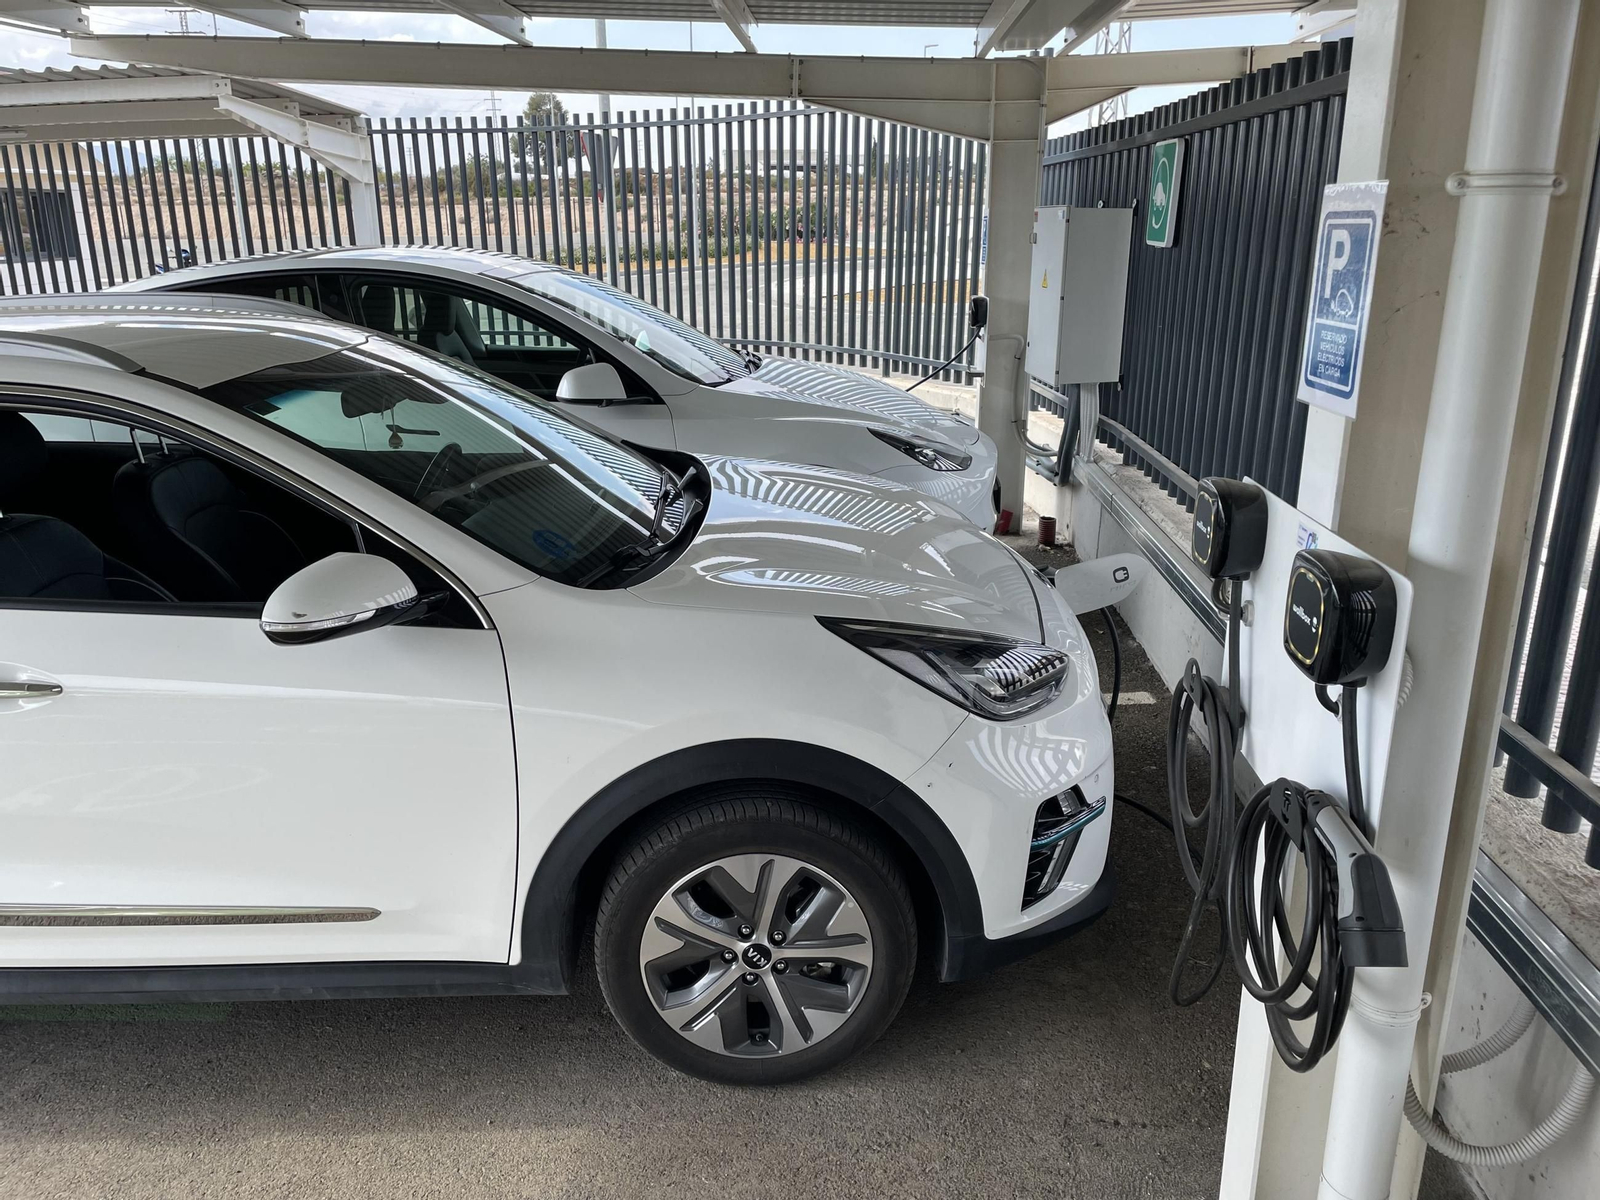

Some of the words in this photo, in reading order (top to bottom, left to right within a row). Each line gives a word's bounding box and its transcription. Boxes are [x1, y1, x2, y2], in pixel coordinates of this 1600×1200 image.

[1324, 229, 1351, 299] P
[1320, 330, 1347, 344] RESERVADO
[1317, 363, 1325, 374] EN
[1324, 365, 1341, 378] CARGA
[1292, 603, 1311, 626] wallbox
[747, 947, 768, 968] KIA
